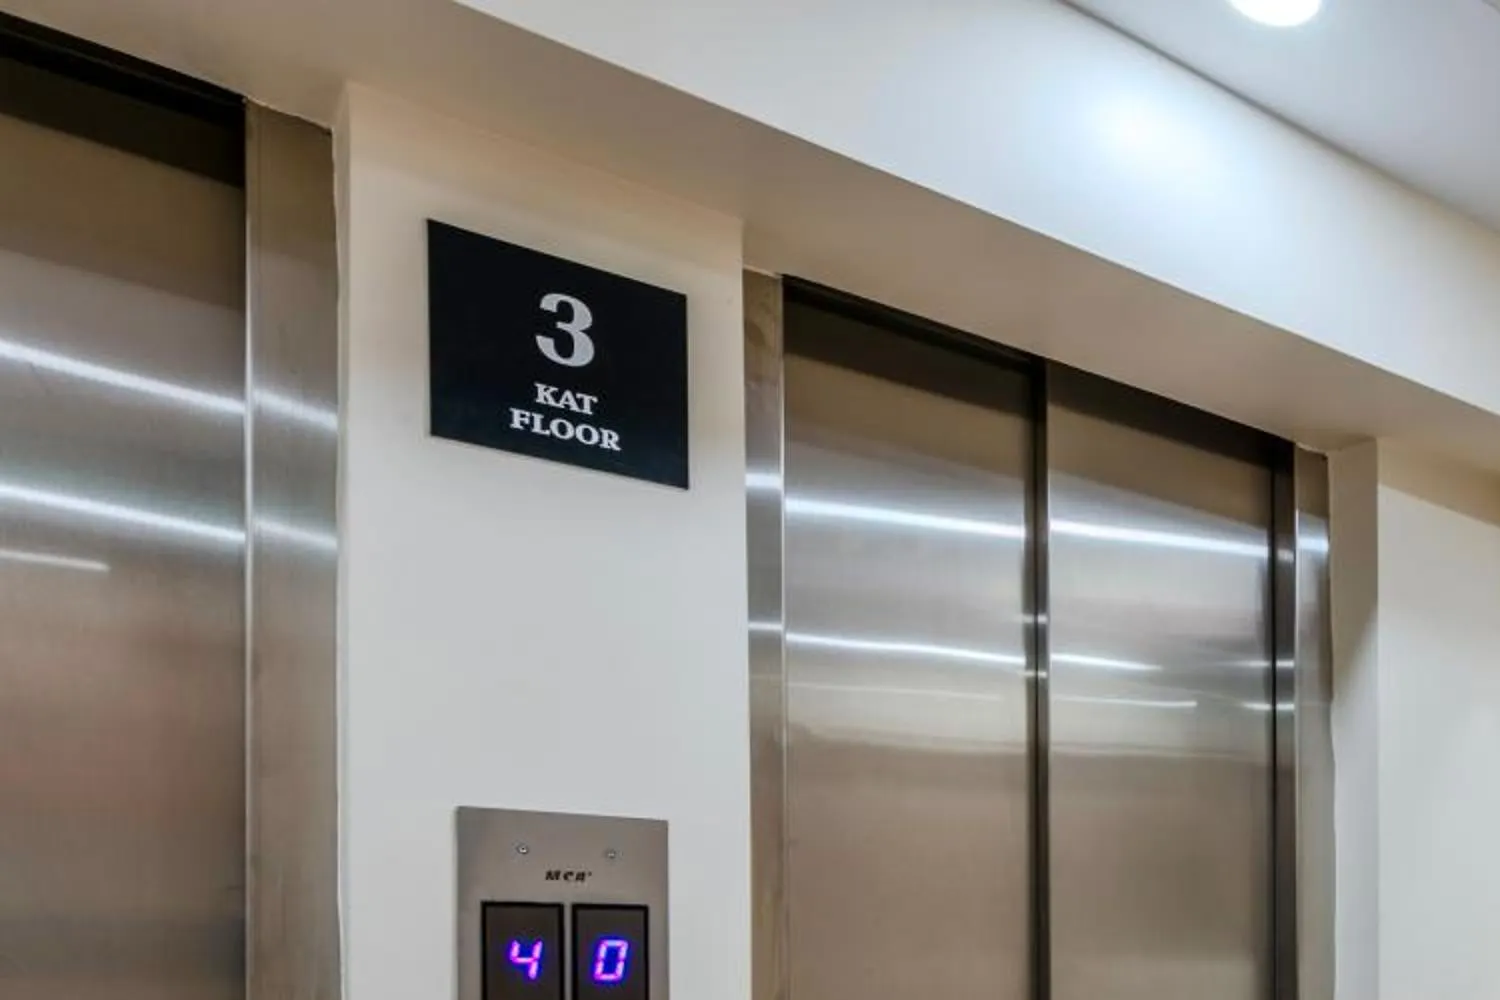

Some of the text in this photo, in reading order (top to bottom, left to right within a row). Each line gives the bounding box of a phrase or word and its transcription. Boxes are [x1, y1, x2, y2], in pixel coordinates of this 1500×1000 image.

[535, 292, 596, 367] 3
[533, 381, 599, 415] KAT
[508, 407, 622, 451] FLOOR
[510, 938, 630, 982] 4 0
